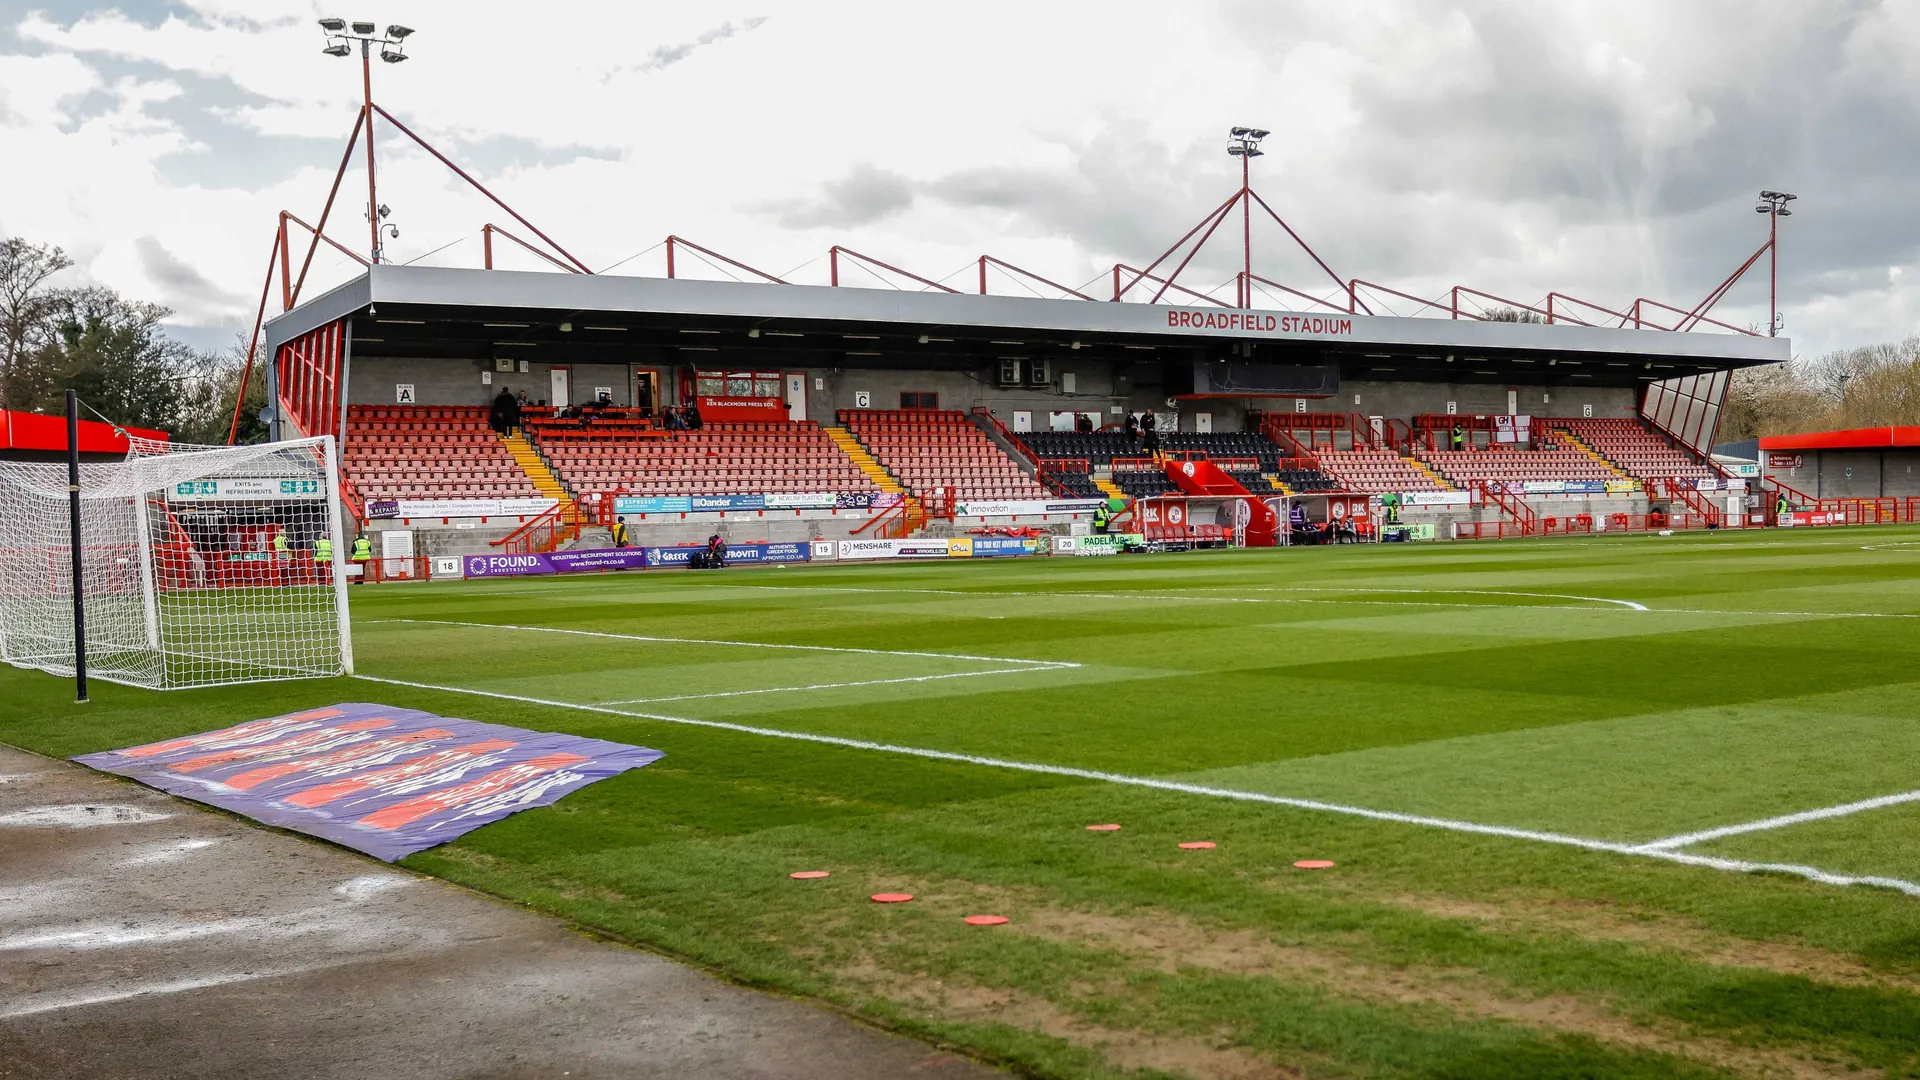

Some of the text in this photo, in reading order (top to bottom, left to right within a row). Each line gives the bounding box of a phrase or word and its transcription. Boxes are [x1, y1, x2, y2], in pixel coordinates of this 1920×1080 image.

[1168, 311, 1351, 334] BROADFIELD STADIUM
[400, 389, 412, 402] A
[859, 395, 867, 407] C
[1298, 402, 1304, 412] E
[1585, 408, 1591, 417] G
[971, 504, 1009, 513] innovation
[853, 542, 892, 550] MENSHARE
[662, 549, 759, 561] GREEK FROVITI
[443, 562, 453, 570] 18
[490, 556, 541, 568] FOUND.
[570, 558, 625, 567] www.found-rs.co.uk
